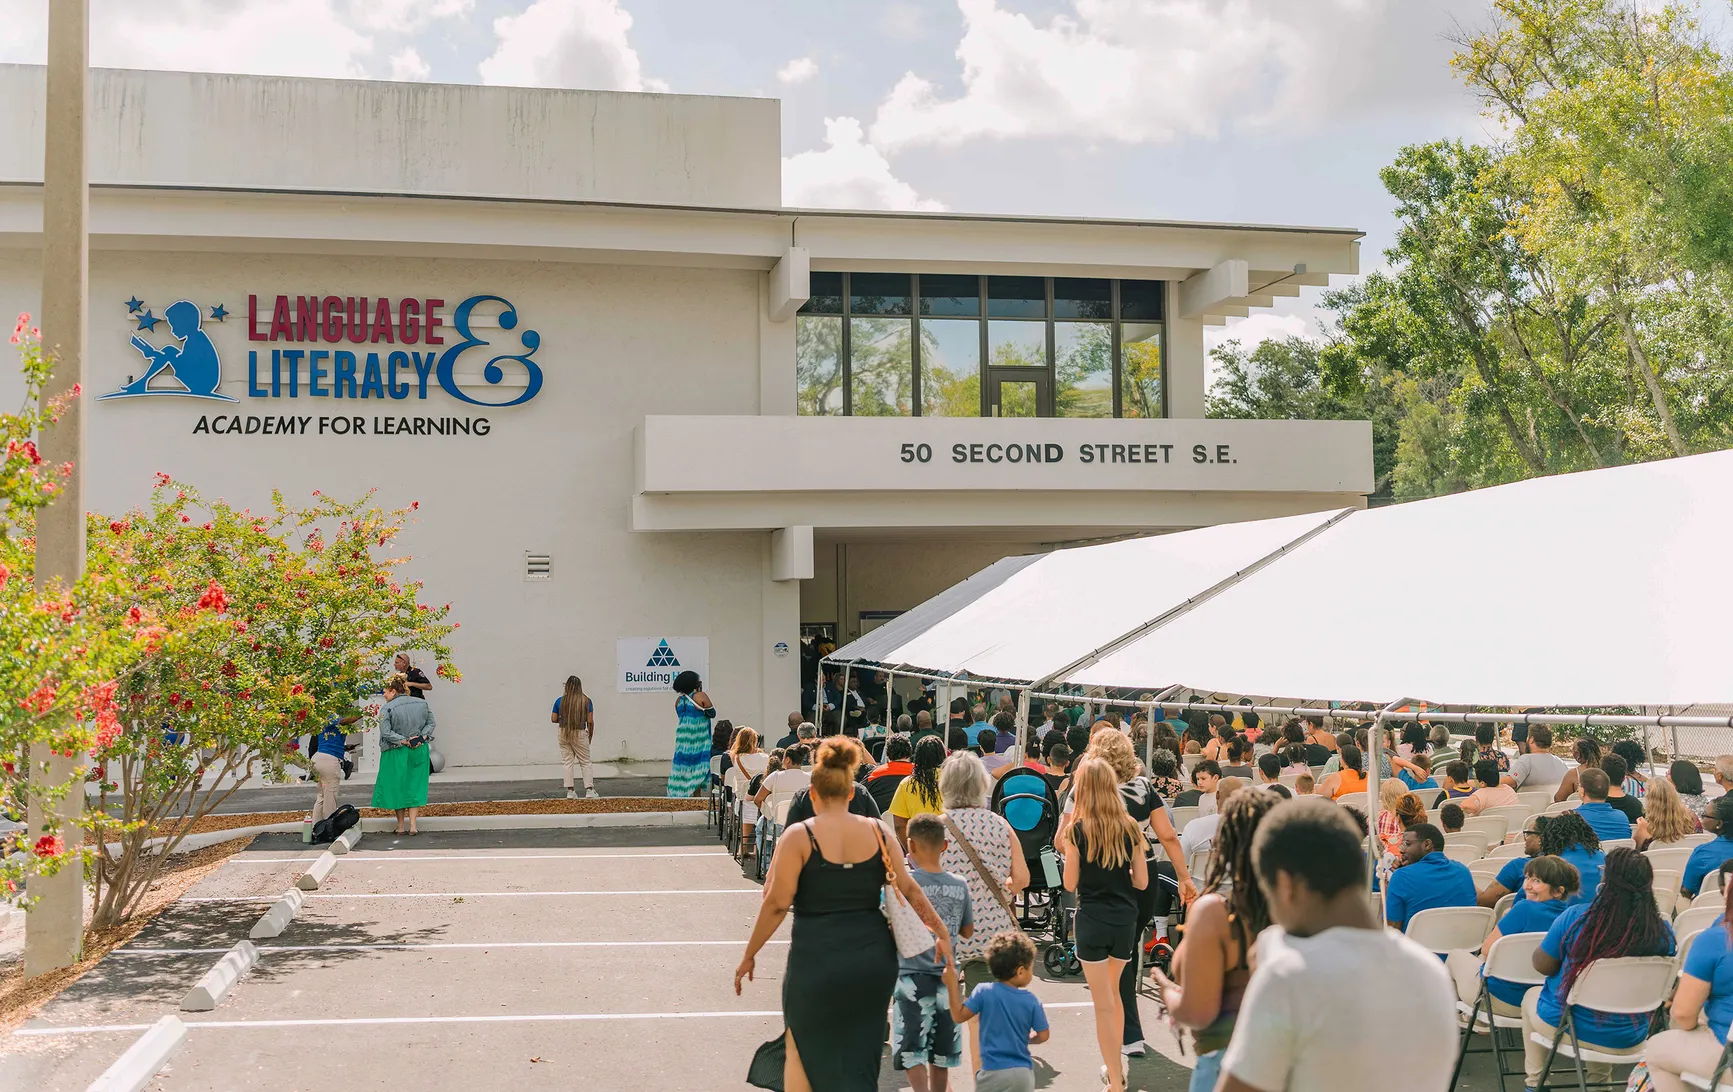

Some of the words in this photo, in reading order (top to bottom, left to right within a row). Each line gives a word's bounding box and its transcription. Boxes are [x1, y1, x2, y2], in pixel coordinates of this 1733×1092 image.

[248, 295, 445, 345] LANGUAGE
[436, 295, 543, 407] &
[248, 349, 436, 400] LITERACY
[192, 415, 313, 435] ACADEMY
[319, 416, 366, 435] FOR
[373, 416, 491, 436] LEARNING
[900, 443, 933, 463] 50
[952, 443, 1064, 463] SECOND
[1079, 444, 1174, 464] STREET
[1192, 444, 1238, 464] S.E.
[625, 671, 670, 685] Building
